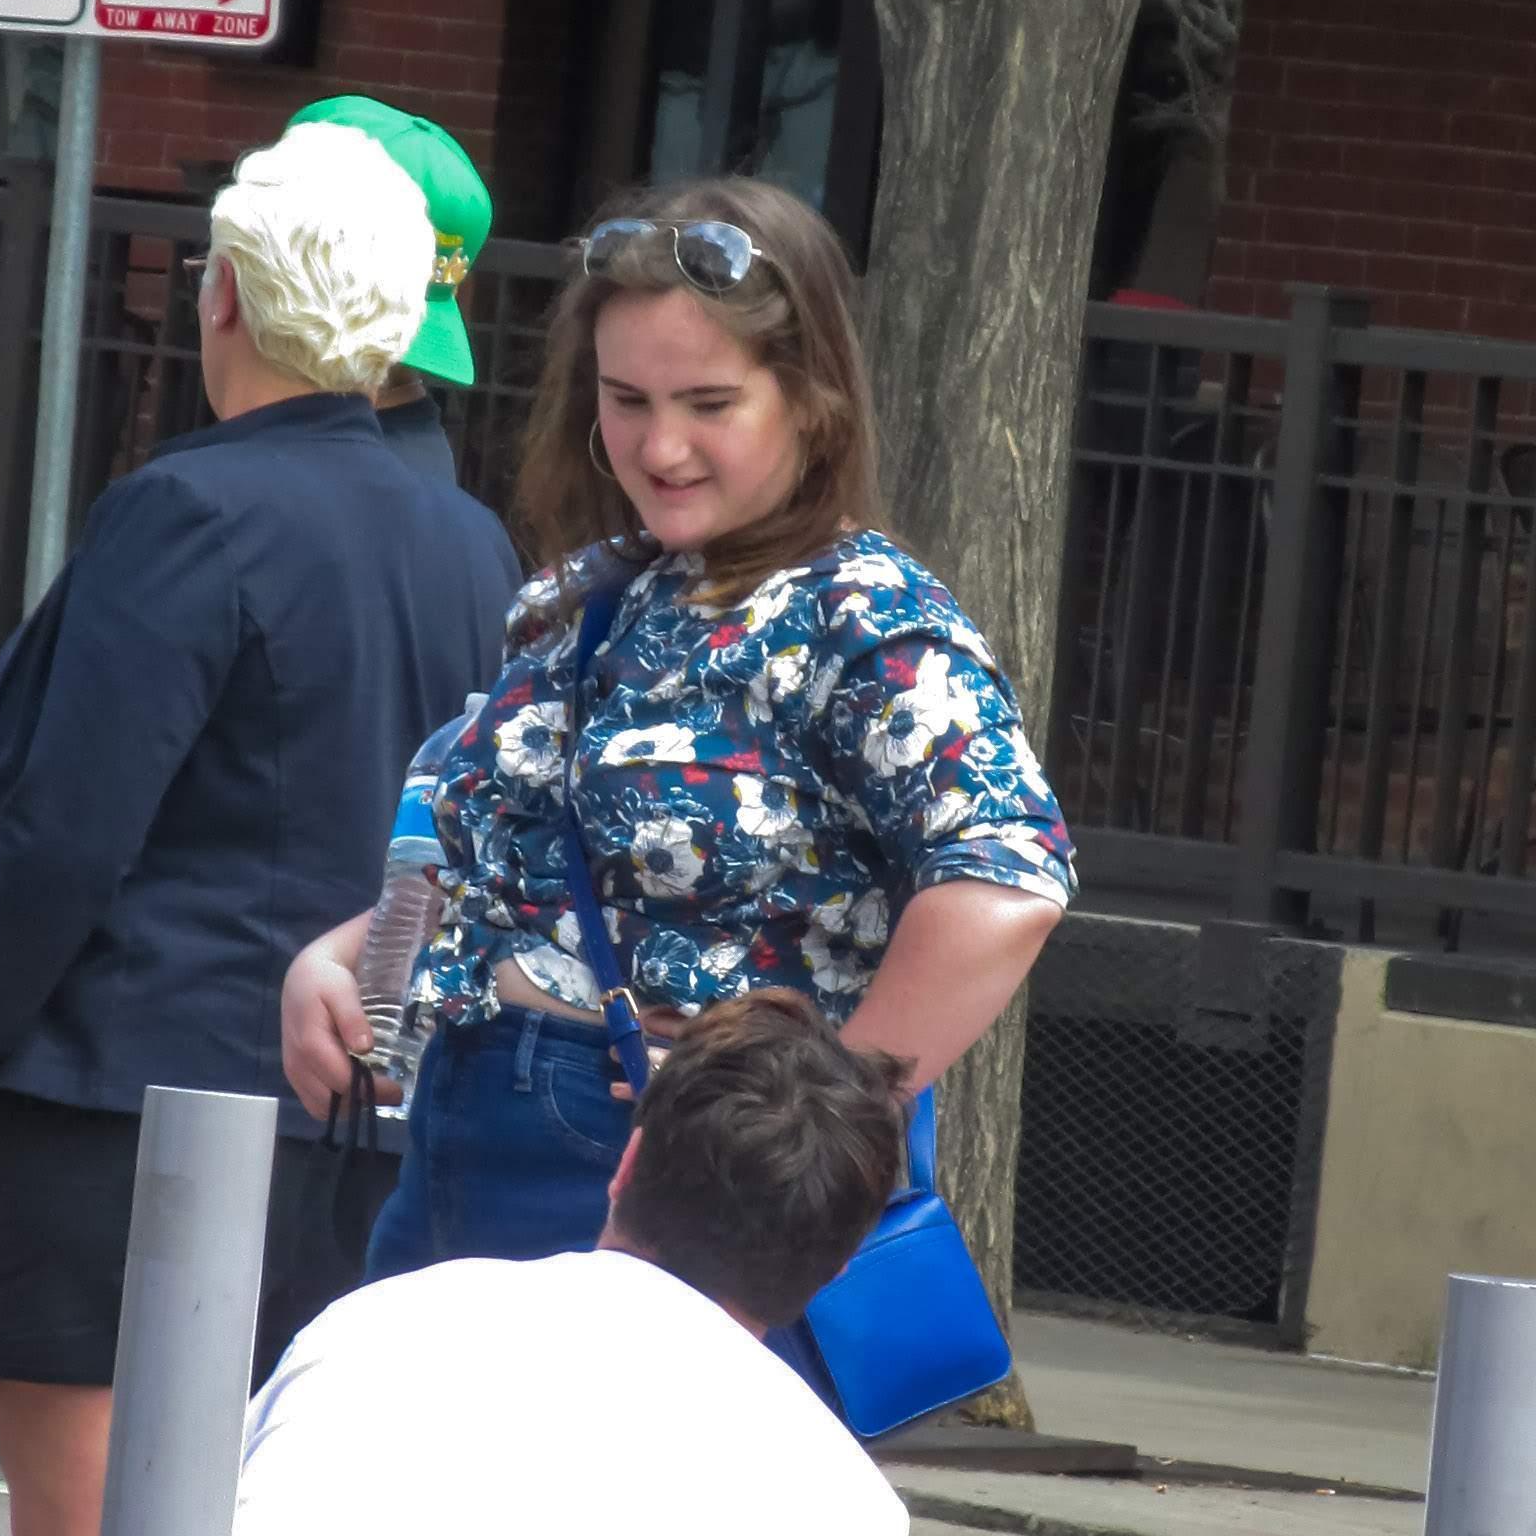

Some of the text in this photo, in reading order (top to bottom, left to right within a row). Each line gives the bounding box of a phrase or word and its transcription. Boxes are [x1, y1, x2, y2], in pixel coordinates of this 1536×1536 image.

[106, 8, 259, 36] TOW AWAY ZONE
